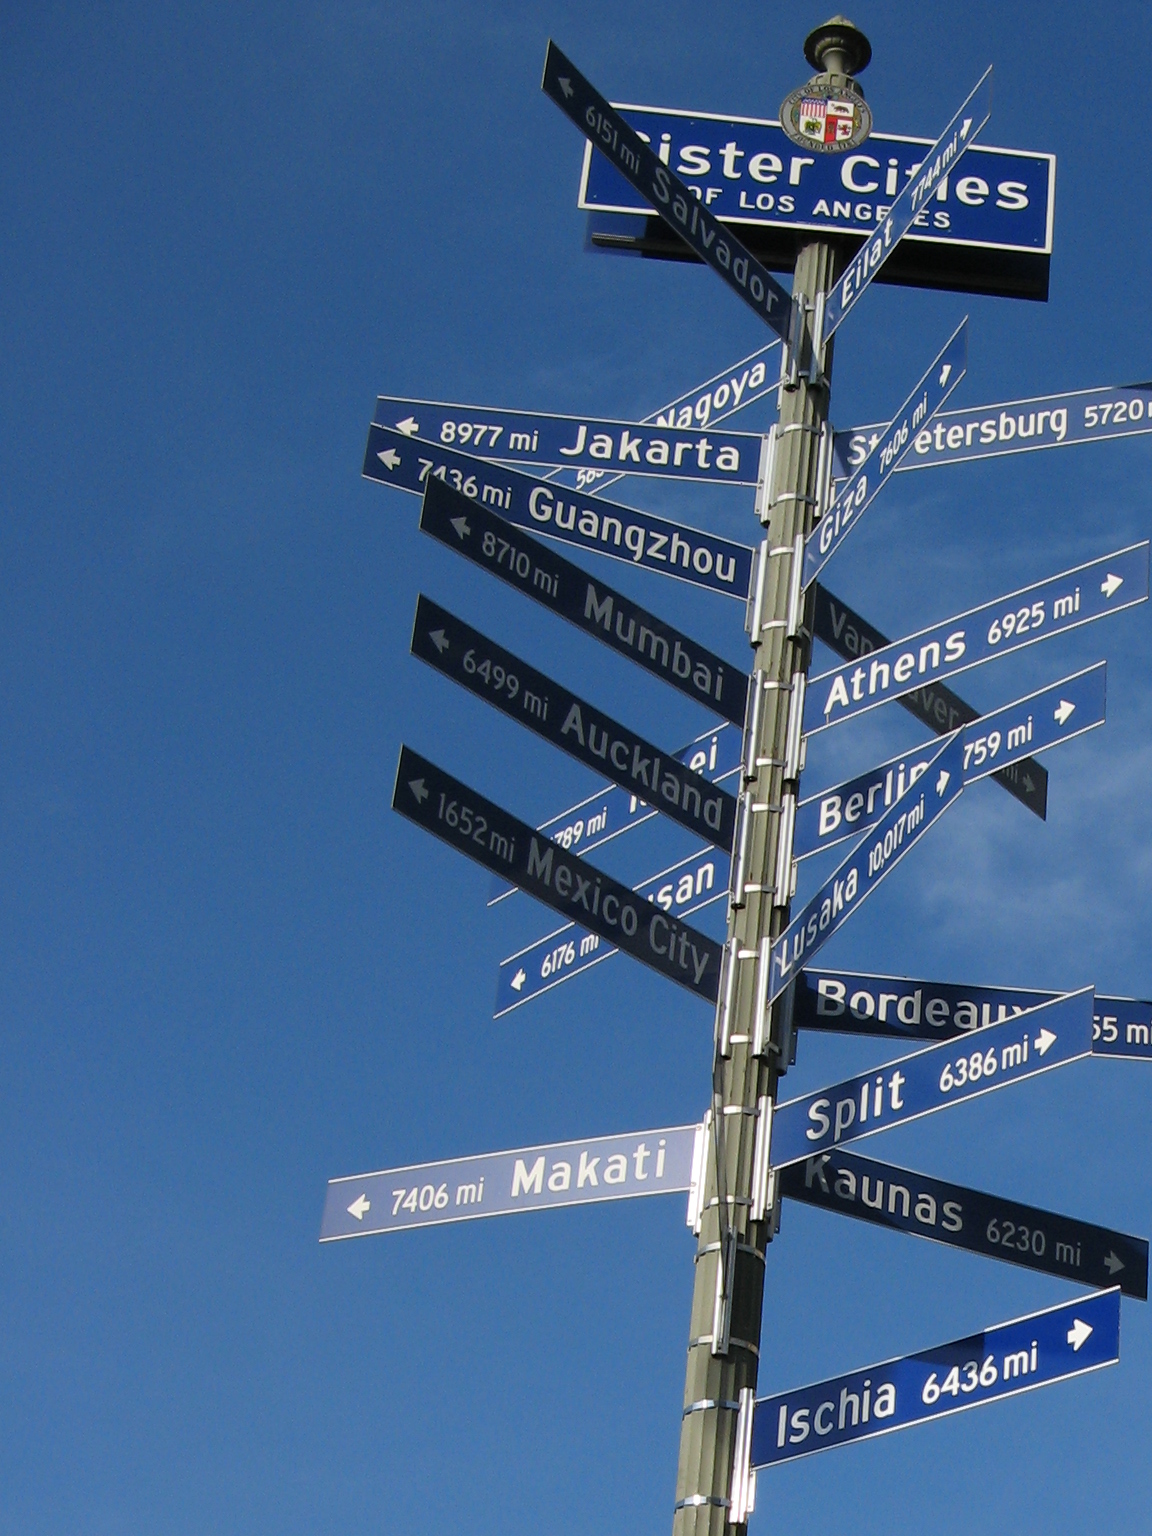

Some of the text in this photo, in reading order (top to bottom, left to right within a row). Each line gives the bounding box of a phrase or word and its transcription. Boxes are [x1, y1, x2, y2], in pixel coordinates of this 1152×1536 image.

[585, 105, 779, 316] 6151 mi Salvador
[635, 130, 814, 186] ister
[739, 191, 795, 212] LOS
[812, 198, 950, 229] ANGEES
[841, 131, 958, 309] Eilat 7744 mi
[440, 421, 740, 471] 8977 mi Jakarta
[819, 391, 928, 555] Giza 7606 mi
[914, 407, 1068, 454] etersburg
[1083, 399, 1144, 428] 5720
[482, 484, 513, 509] mi
[528, 487, 737, 583] Guangzhou
[481, 530, 723, 702] 8710 mi Mumbai
[823, 588, 1080, 714] Athens 6925 mi
[462, 649, 520, 700] 6499
[523, 690, 549, 722] mi
[560, 703, 723, 832] Auckland
[819, 716, 1033, 836] Berlin 759 mi
[550, 806, 608, 849] 789 mi
[438, 793, 712, 985] 1652 mi Mexico City
[541, 940, 576, 978] 6176
[647, 862, 715, 912] san
[779, 793, 924, 978] Lusaka 10,017 mi
[806, 1034, 1030, 1141] Split 6386 mi
[391, 1139, 667, 1216] 7406 mi Makati
[804, 1154, 1081, 1268] Kaunas 6230 mi
[776, 1341, 1038, 1448] Ischia 6436 mi
